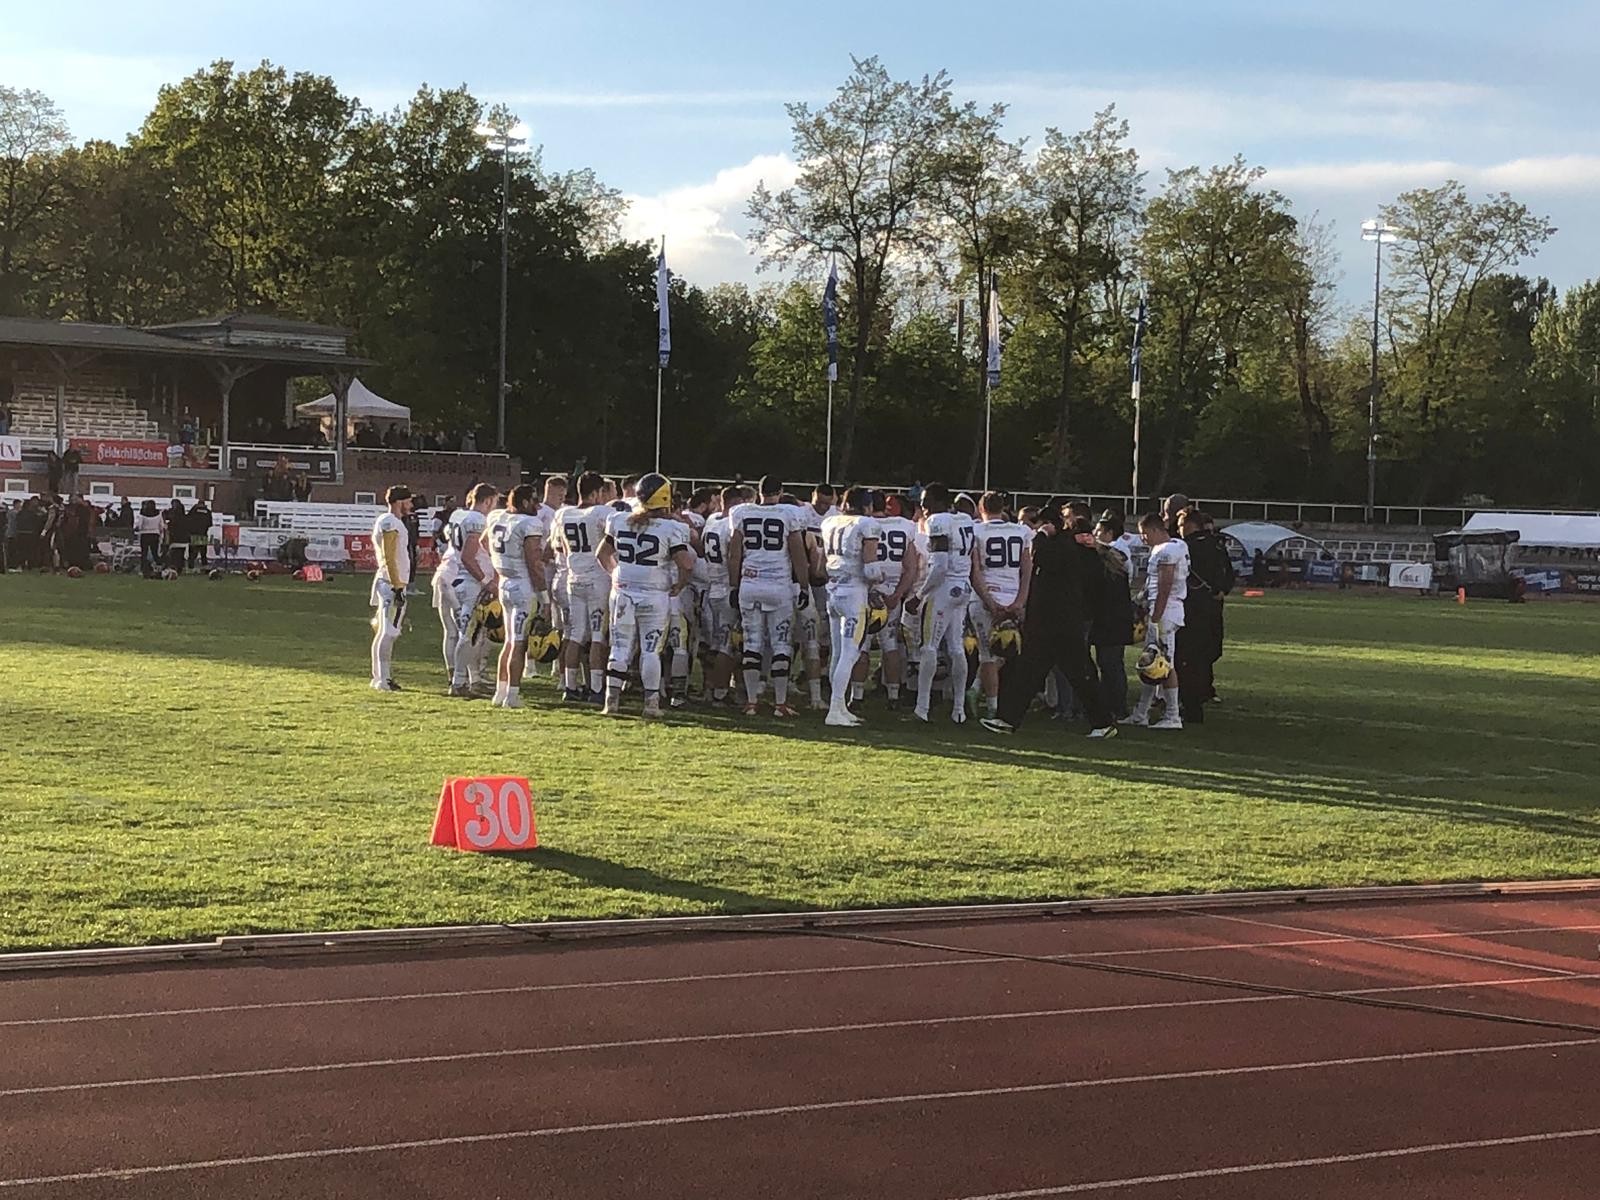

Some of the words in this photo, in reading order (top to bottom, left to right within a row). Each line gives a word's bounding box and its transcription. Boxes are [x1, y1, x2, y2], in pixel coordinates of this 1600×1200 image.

[564, 522, 592, 553] 91
[617, 530, 660, 566] 52
[743, 518, 785, 551] 59
[827, 527, 846, 556] 11
[959, 526, 975, 556] 17
[985, 536, 1024, 568] 90
[307, 567, 323, 580] 40
[464, 781, 530, 847] 30
